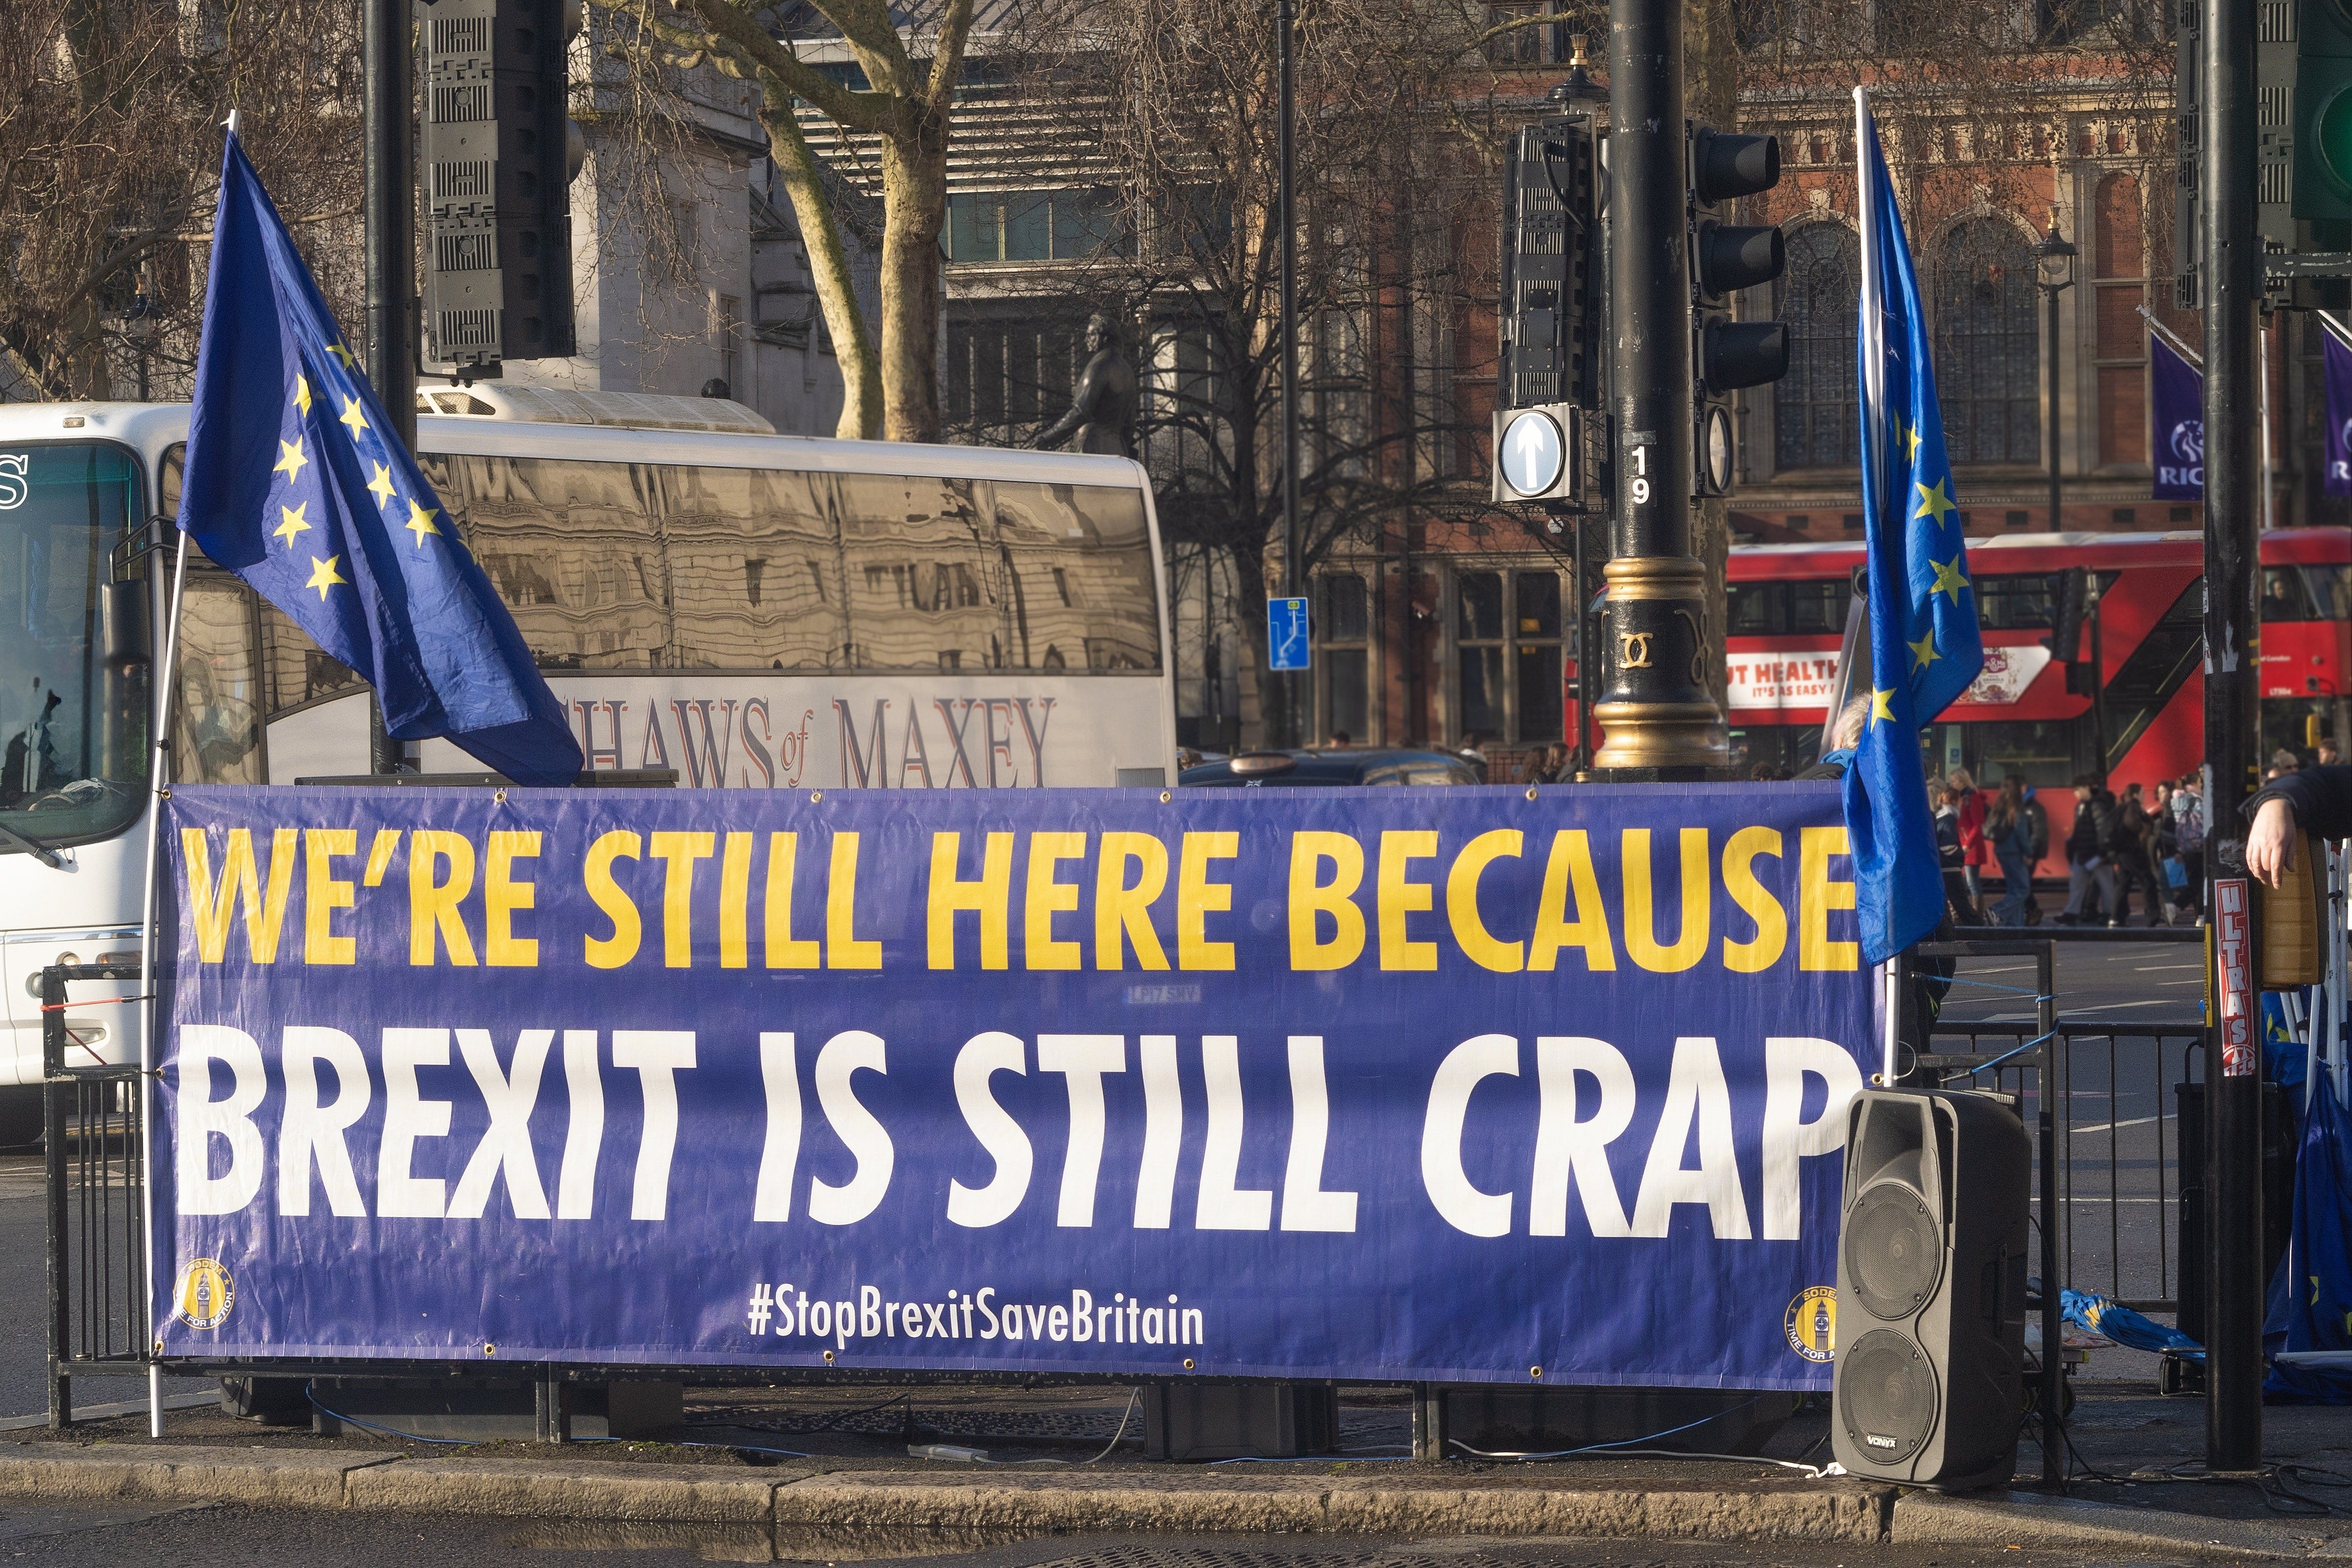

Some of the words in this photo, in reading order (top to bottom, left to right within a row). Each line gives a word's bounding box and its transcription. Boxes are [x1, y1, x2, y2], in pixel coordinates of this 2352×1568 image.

[2160, 466, 2204, 485] RIC
[1753, 686, 1775, 697] IT'S
[1796, 684, 1826, 696] EASY
[559, 694, 775, 788] HAWS
[781, 709, 814, 787] of
[832, 695, 1057, 788] MAXEY
[181, 828, 541, 966] WE'RE
[585, 831, 882, 969] STILL
[928, 832, 1238, 970] HERE
[1289, 826, 1858, 972] BECAUSE
[2221, 886, 2246, 1044] ULTRAS
[178, 1025, 696, 1222] BREXIT
[754, 1031, 894, 1225] IS
[947, 1032, 1358, 1233] STILL
[1421, 1034, 1862, 1241] CRAP
[188, 1260, 224, 1275] SODEM
[187, 1315, 206, 1327] FOR
[210, 1292, 233, 1326] ACTION
[1802, 1288, 1837, 1301] SODE
[748, 1283, 1203, 1349] #StopBrexitSaveBritain
[1788, 1321, 1803, 1349] TIME
[1803, 1347, 1825, 1360] FOR
[1867, 1435, 1896, 1448] VONYX
